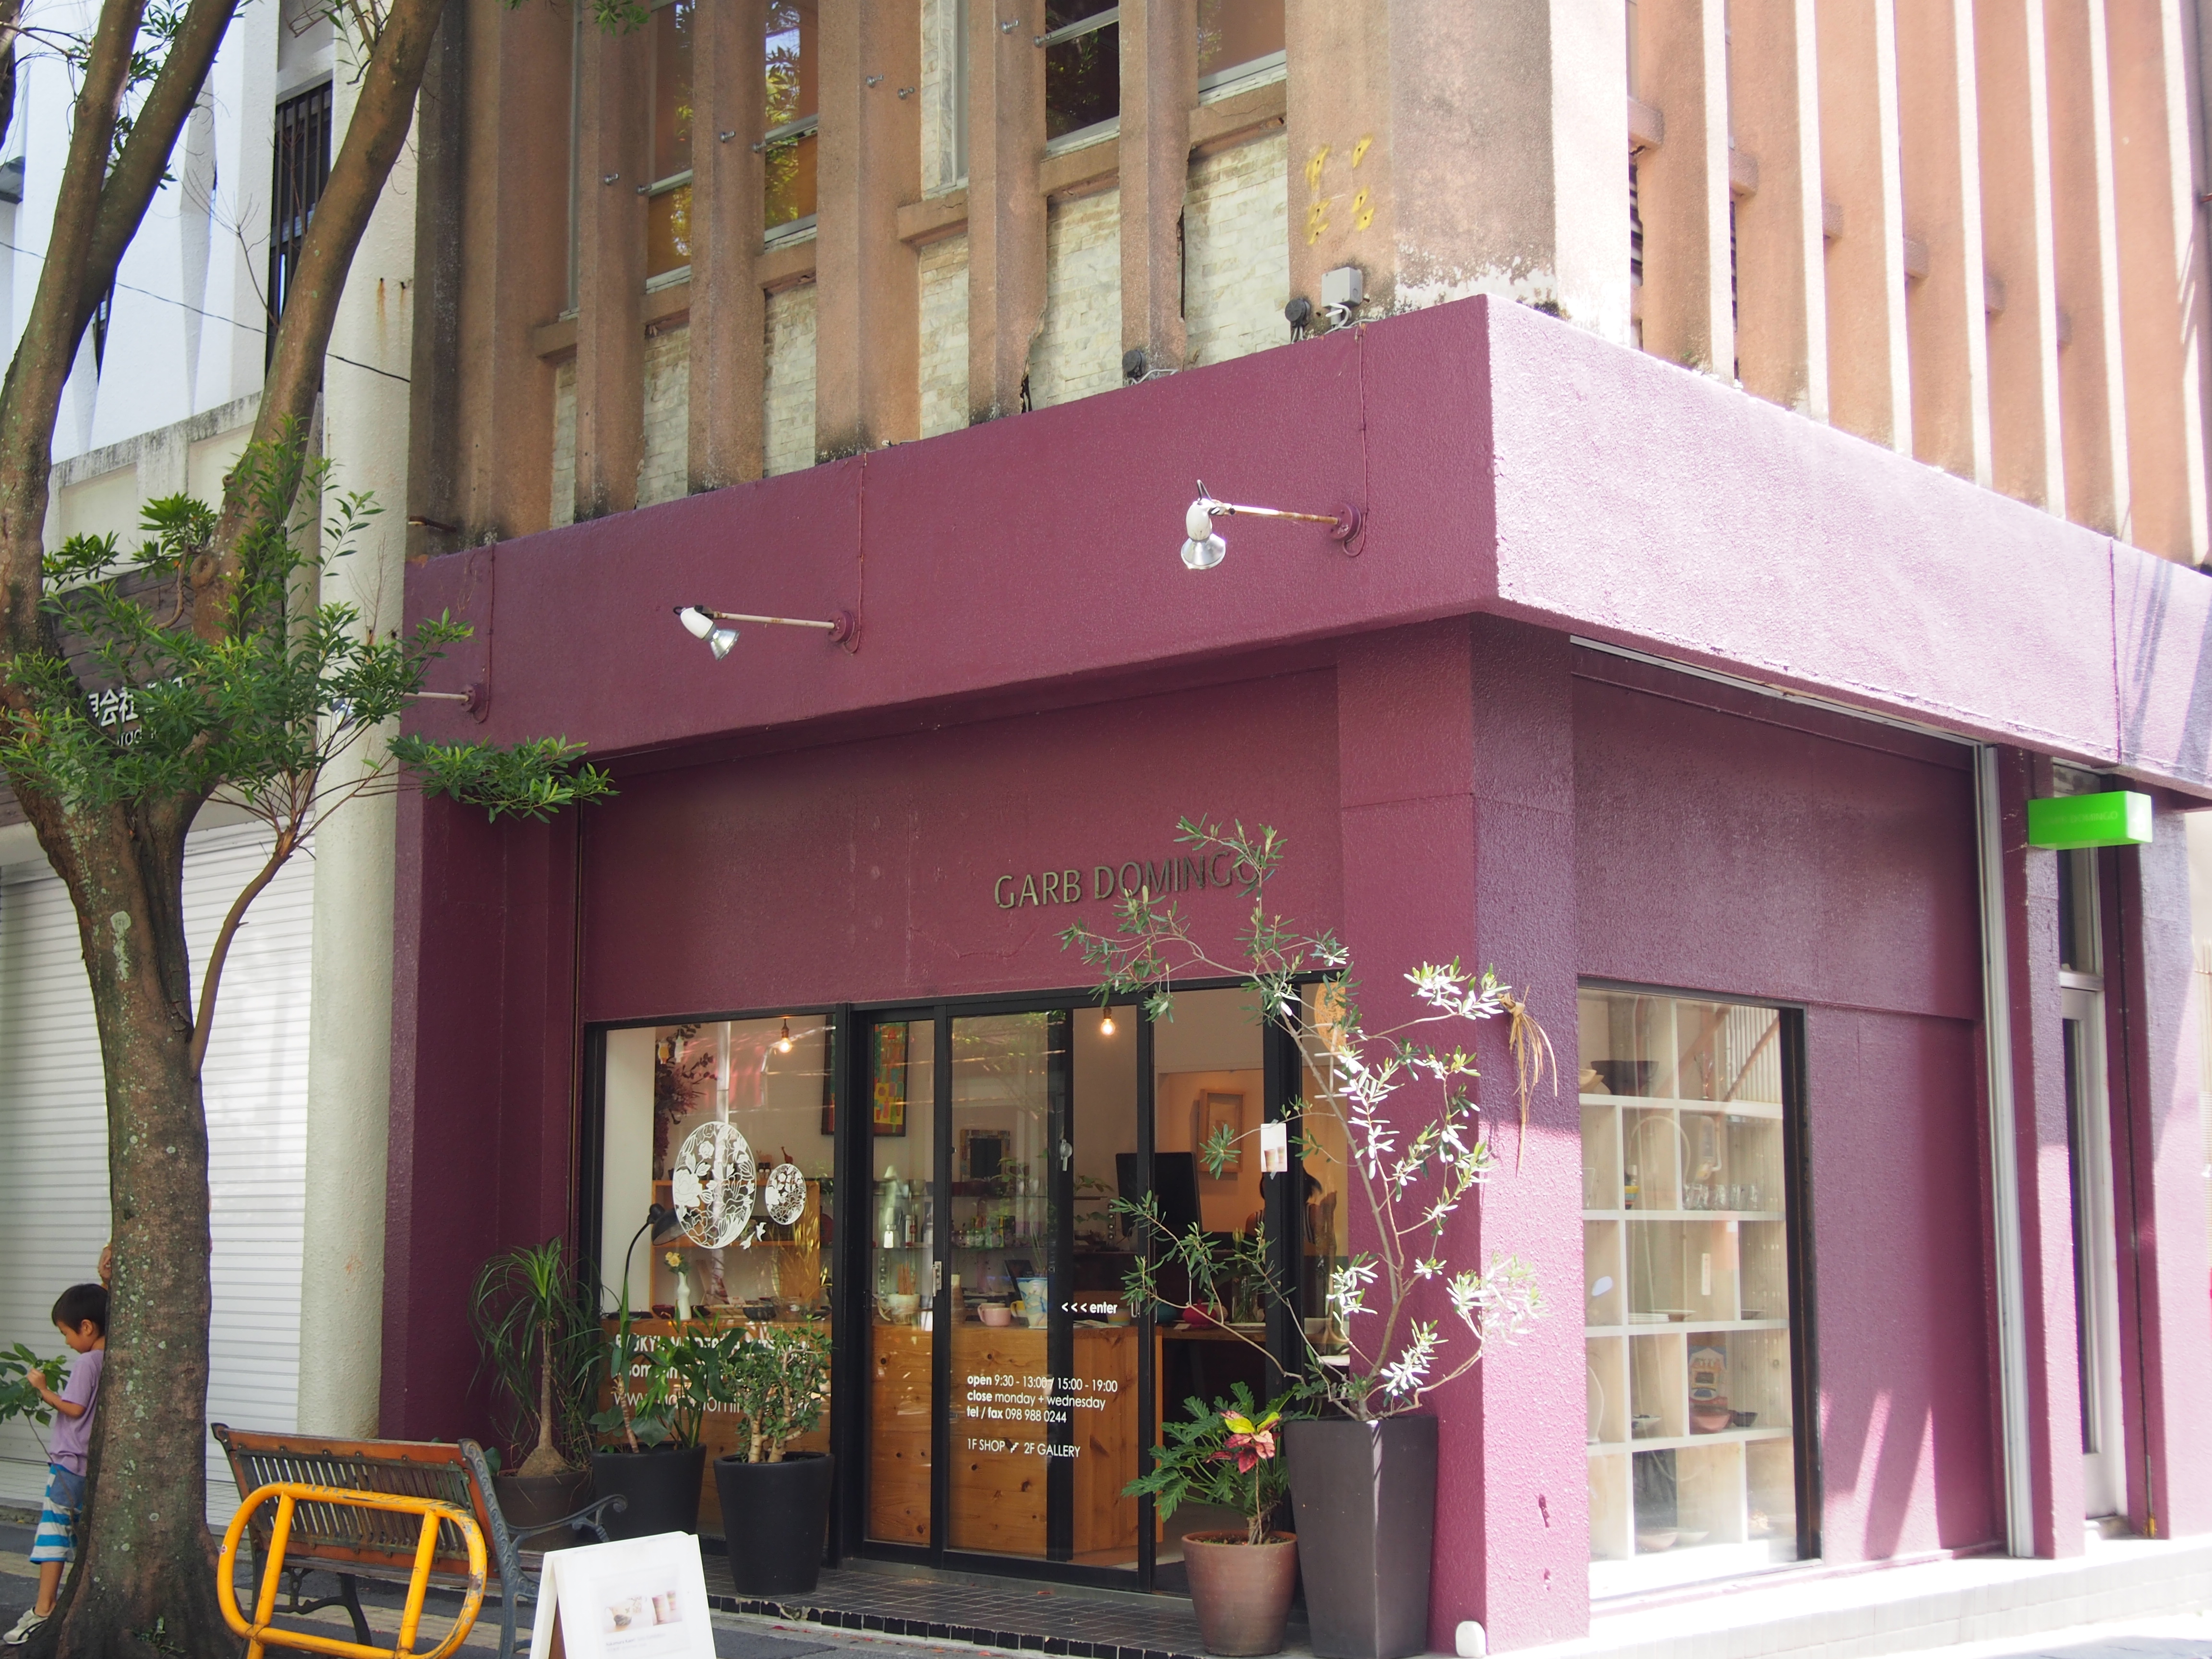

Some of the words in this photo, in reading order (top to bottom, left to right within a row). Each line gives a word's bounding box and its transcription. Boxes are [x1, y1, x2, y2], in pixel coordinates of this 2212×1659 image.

[994, 869, 1082, 909] GARB
[1094, 851, 1260, 900] DOMINGO
[1089, 1301, 1118, 1314] enter
[967, 1376, 992, 1388] open
[994, 1374, 1014, 1387] 9:30
[1023, 1376, 1047, 1388] 13:00
[1058, 1377, 1083, 1391] 15:00
[1092, 1379, 1118, 1393] 19:00
[967, 1390, 993, 1402] close
[995, 1392, 1036, 1407] monday
[1046, 1395, 1106, 1411] wednesday
[967, 1406, 979, 1418] tel
[987, 1407, 1003, 1419] fax
[1005, 1407, 1022, 1420] 098
[1024, 1409, 1042, 1421] 988
[1044, 1410, 1067, 1423] 0244
[967, 1437, 978, 1451] 1F
[979, 1439, 1005, 1453] SHOP
[1024, 1442, 1035, 1455] 2F
[1037, 1443, 1081, 1458] GALLERY
